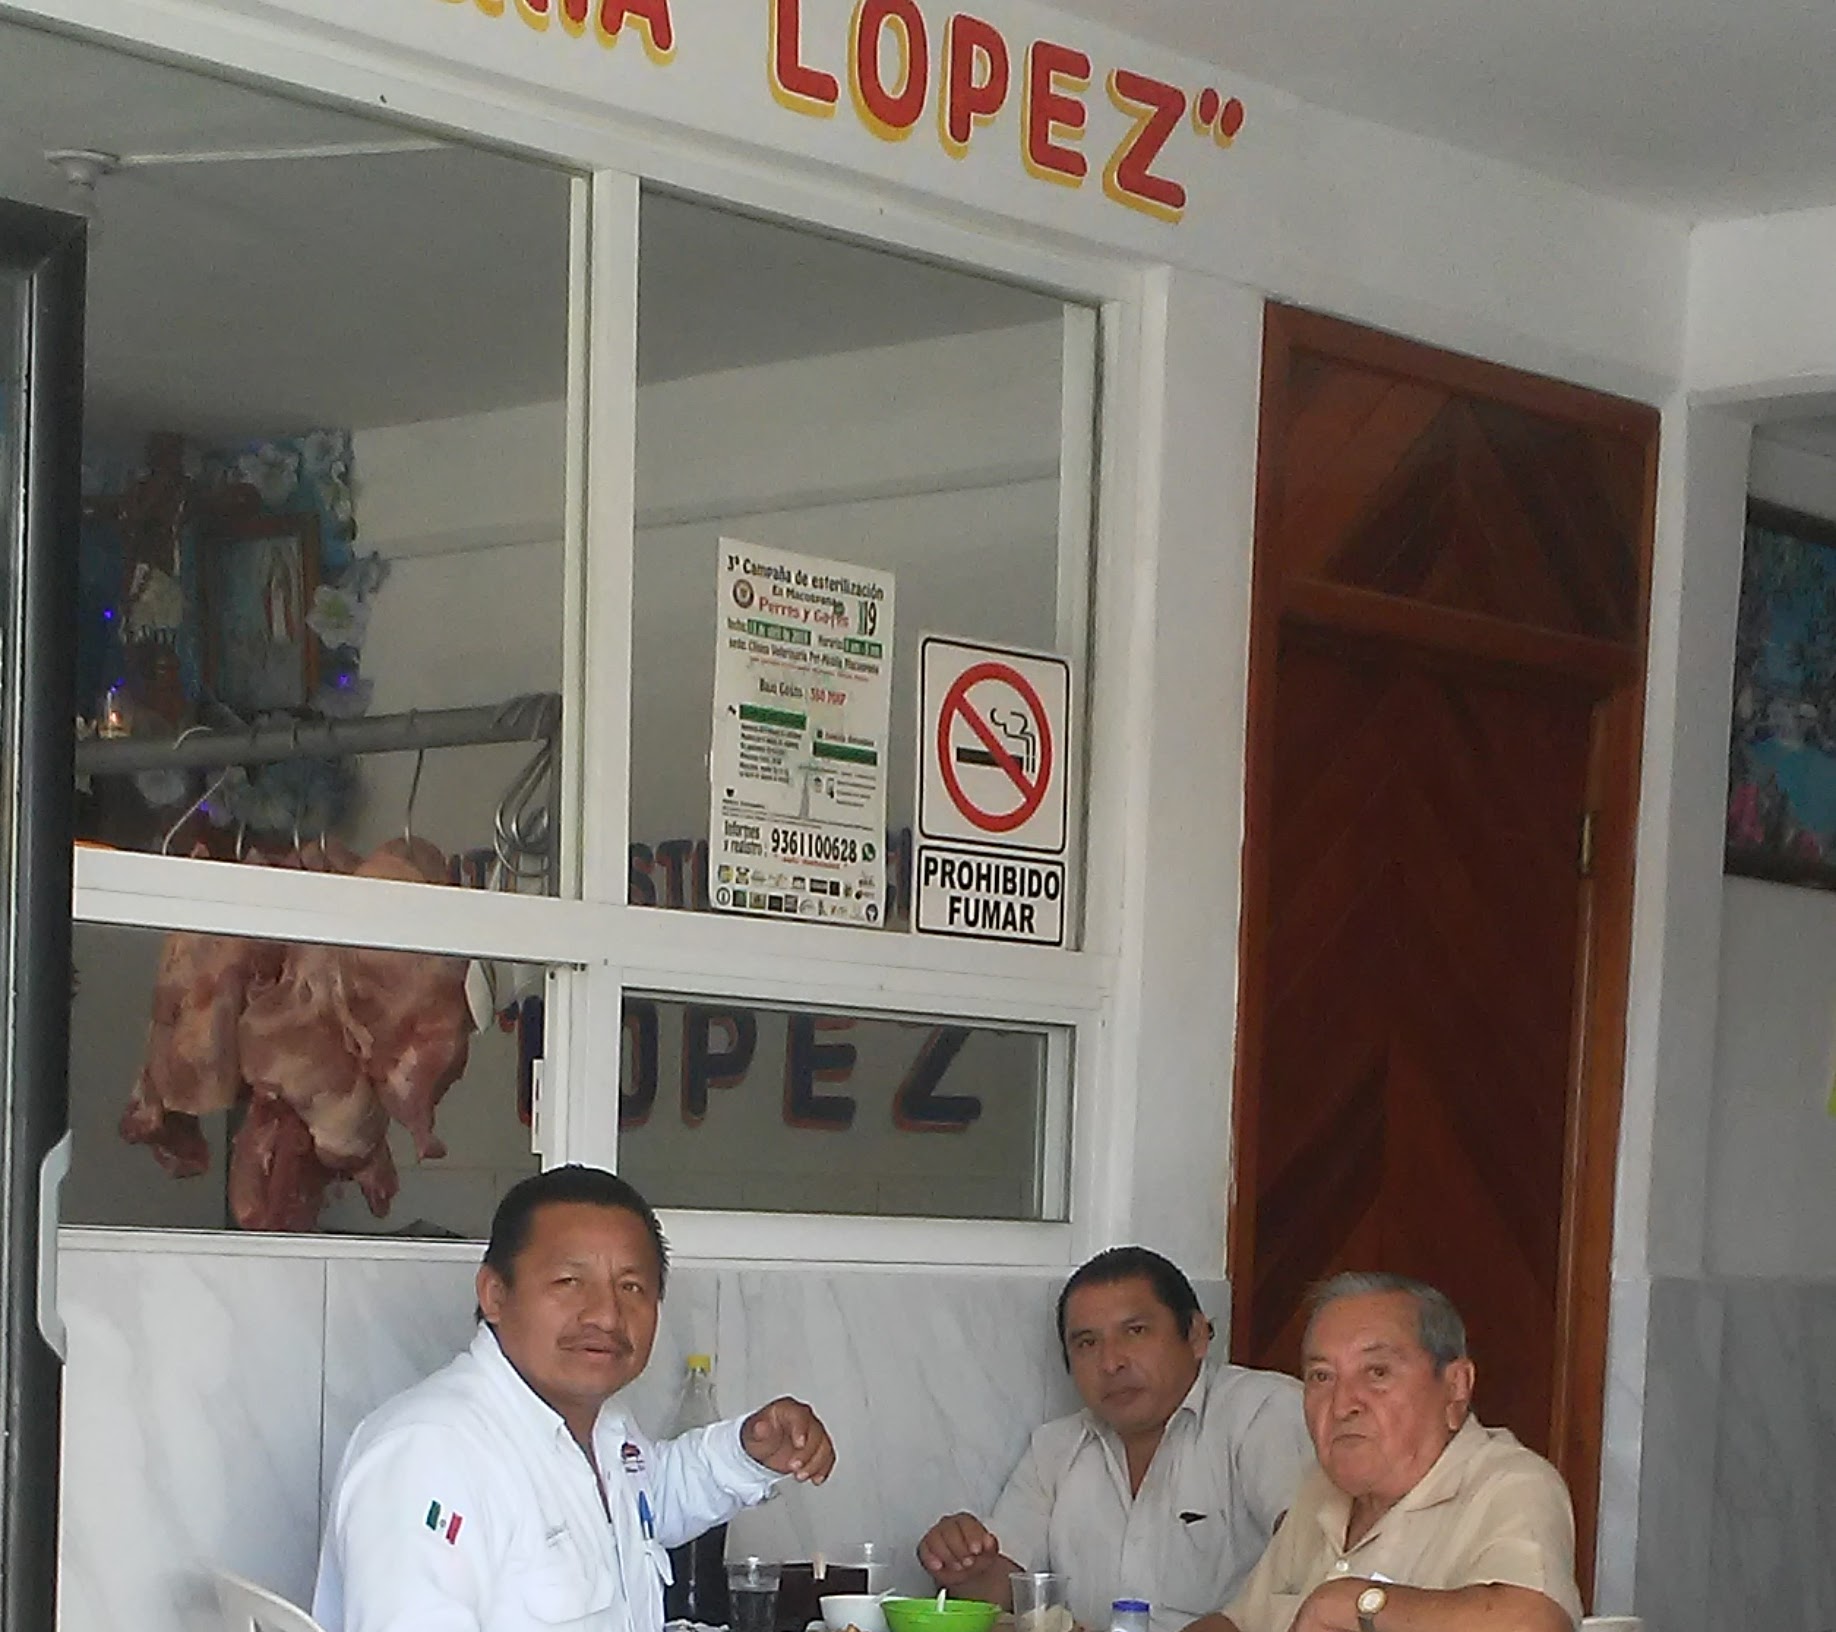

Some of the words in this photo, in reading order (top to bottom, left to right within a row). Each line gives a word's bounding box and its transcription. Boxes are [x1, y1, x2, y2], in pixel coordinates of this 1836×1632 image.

[743, 558, 791, 582] Campaña
[795, 570, 808, 586] de
[771, 828, 857, 863] 9361100628
[924, 856, 1060, 901] PROHIBIDO
[948, 896, 1035, 933] FUMAR
